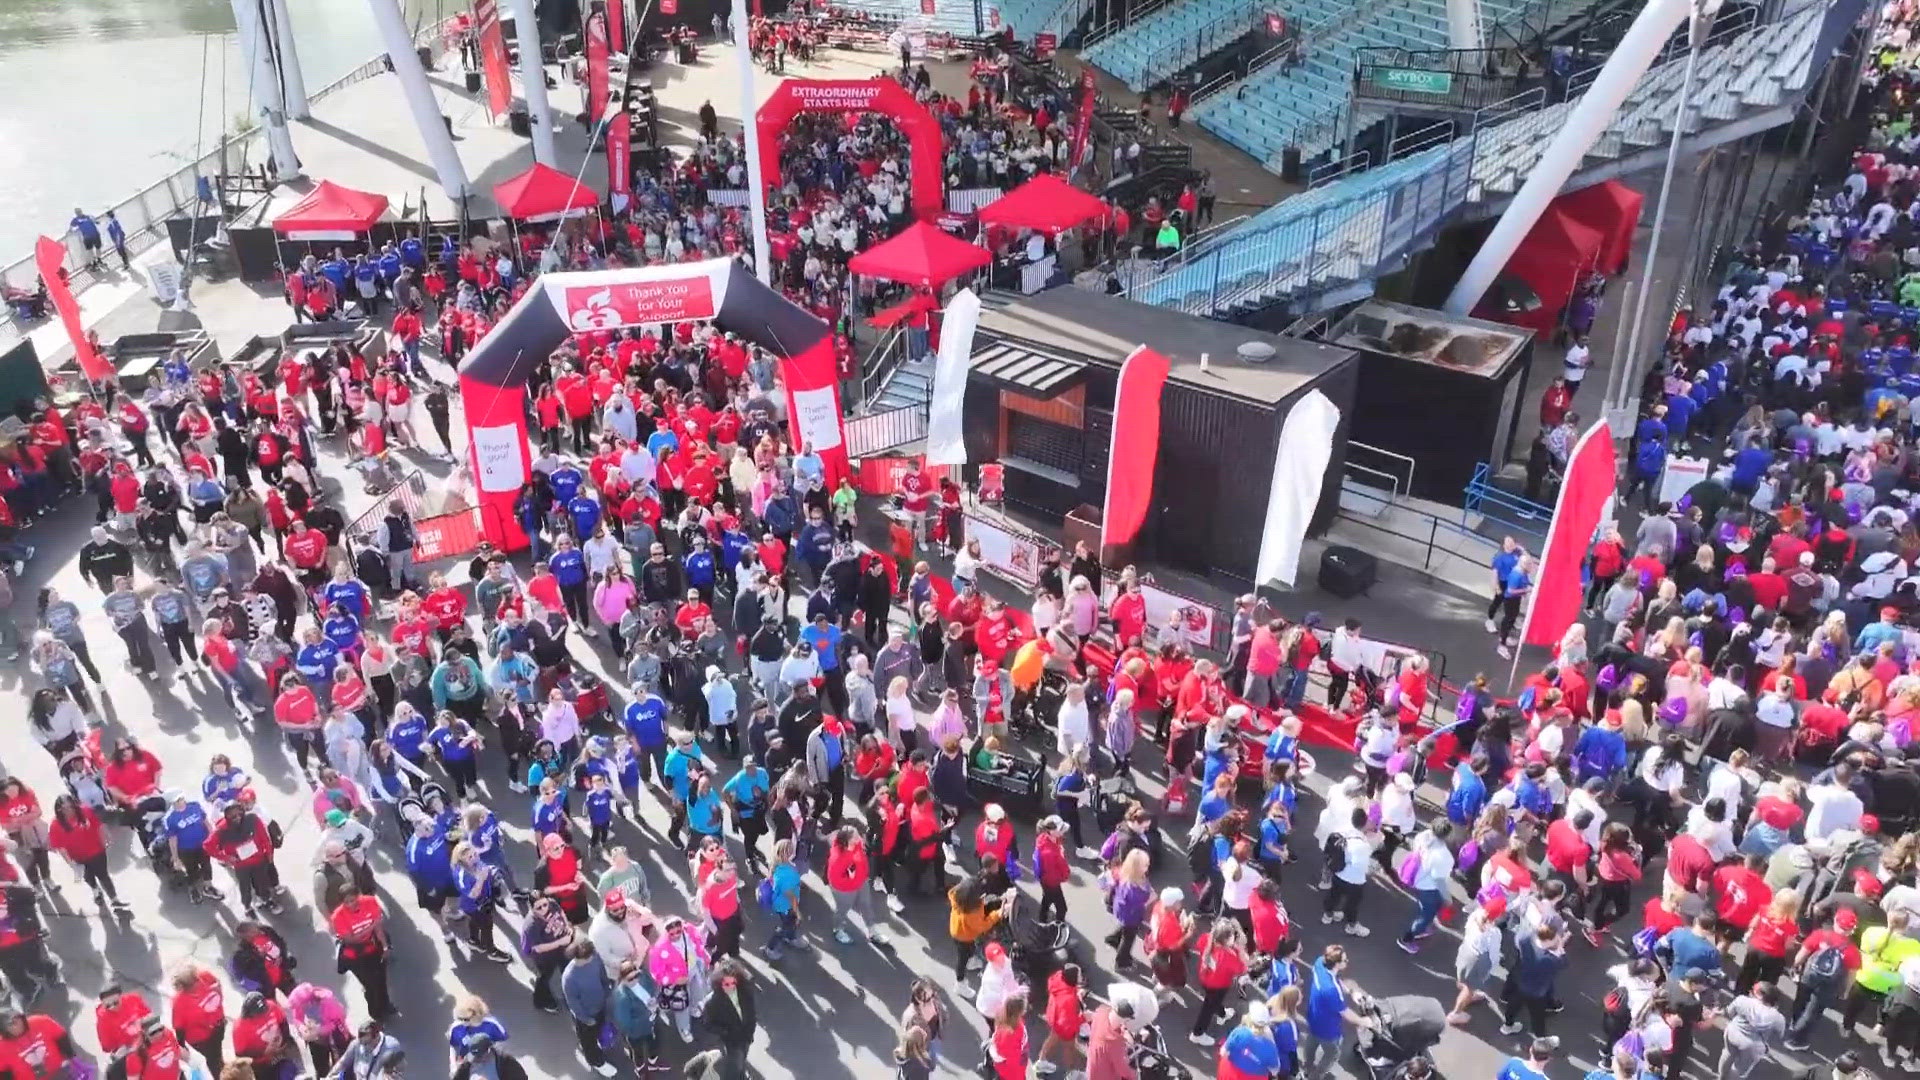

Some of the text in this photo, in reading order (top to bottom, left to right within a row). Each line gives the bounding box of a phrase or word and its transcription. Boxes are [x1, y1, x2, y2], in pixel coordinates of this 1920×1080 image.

[1388, 71, 1433, 84] SKYBOX
[792, 86, 881, 98] EXTRAORDINARY
[803, 98, 870, 108] STARTS HERE
[629, 284, 688, 299] Thank You
[638, 298, 683, 311] for Your
